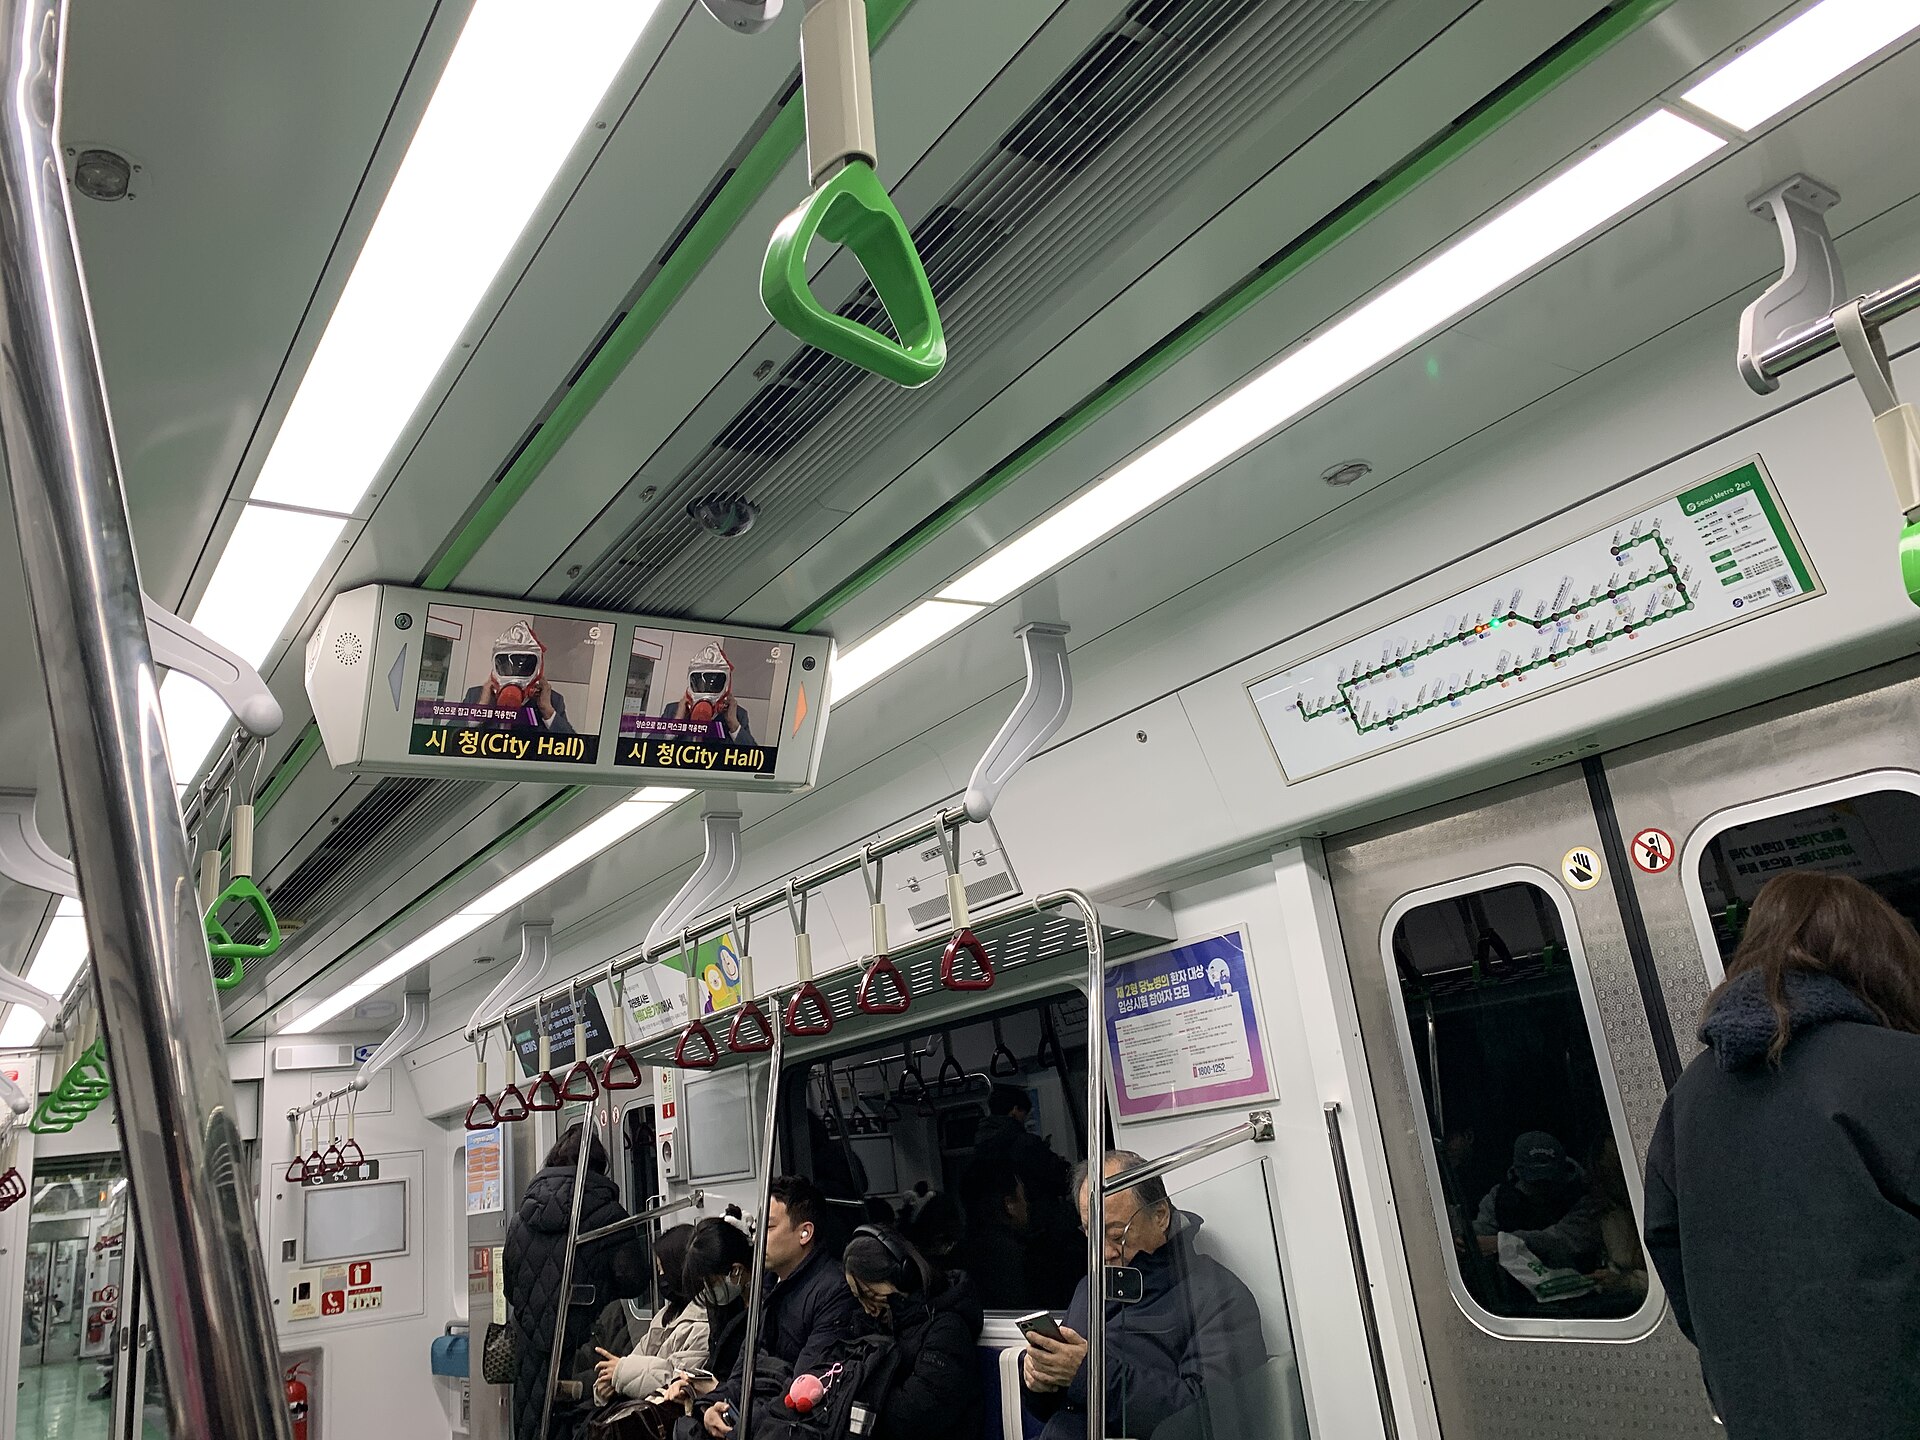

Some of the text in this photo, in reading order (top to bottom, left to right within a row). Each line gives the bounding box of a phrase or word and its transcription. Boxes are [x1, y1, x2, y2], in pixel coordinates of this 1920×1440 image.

[1695, 495, 1715, 508] Seoul
[1713, 487, 1735, 500] Metro
[432, 705, 518, 720] 양손으로 잡고 마스크를 착용한다
[635, 720, 656, 730] 양손으로
[667, 722, 688, 732] 마스크를
[424, 729, 585, 760] 시 청(City Hall)
[627, 741, 765, 770] 시 청(City Hall)
[1115, 964, 1205, 1000] 제 2형 당뇨병의 환자 대상
[1117, 984, 1191, 1014] 임상시험 참여자 모집
[521, 1040, 538, 1055] NEWS
[1197, 1062, 1227, 1076] 1800-1252
